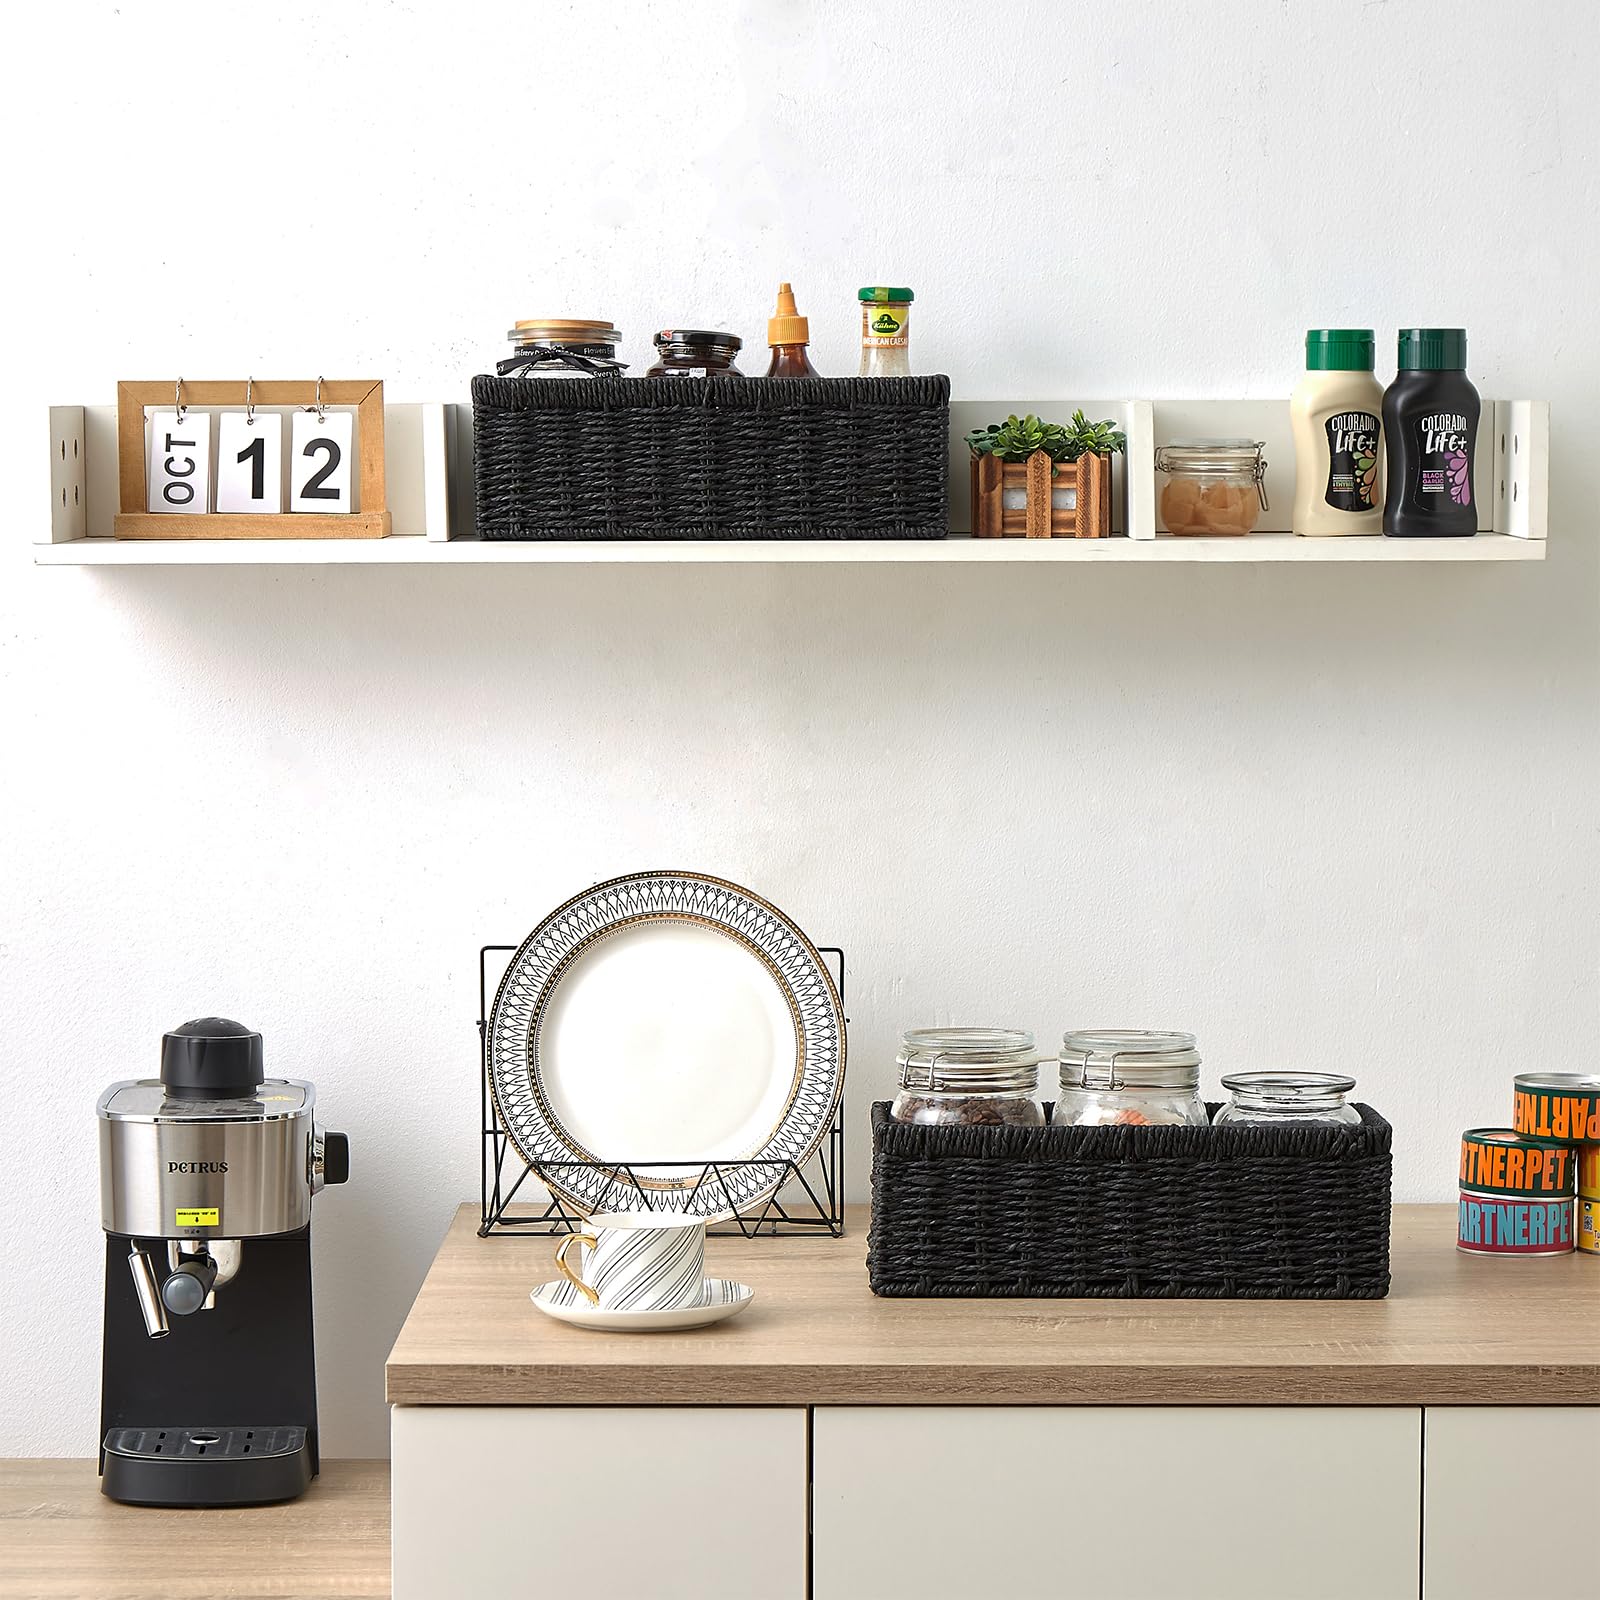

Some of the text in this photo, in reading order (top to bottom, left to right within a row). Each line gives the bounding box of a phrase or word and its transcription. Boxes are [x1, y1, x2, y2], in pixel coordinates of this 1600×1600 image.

[1331, 414, 1375, 432] COLORADO
[1421, 414, 1467, 432] COLORADO
[163, 433, 196, 505] OCT
[237, 437, 341, 500] 1 2
[168, 1161, 229, 1174] PETRUS
